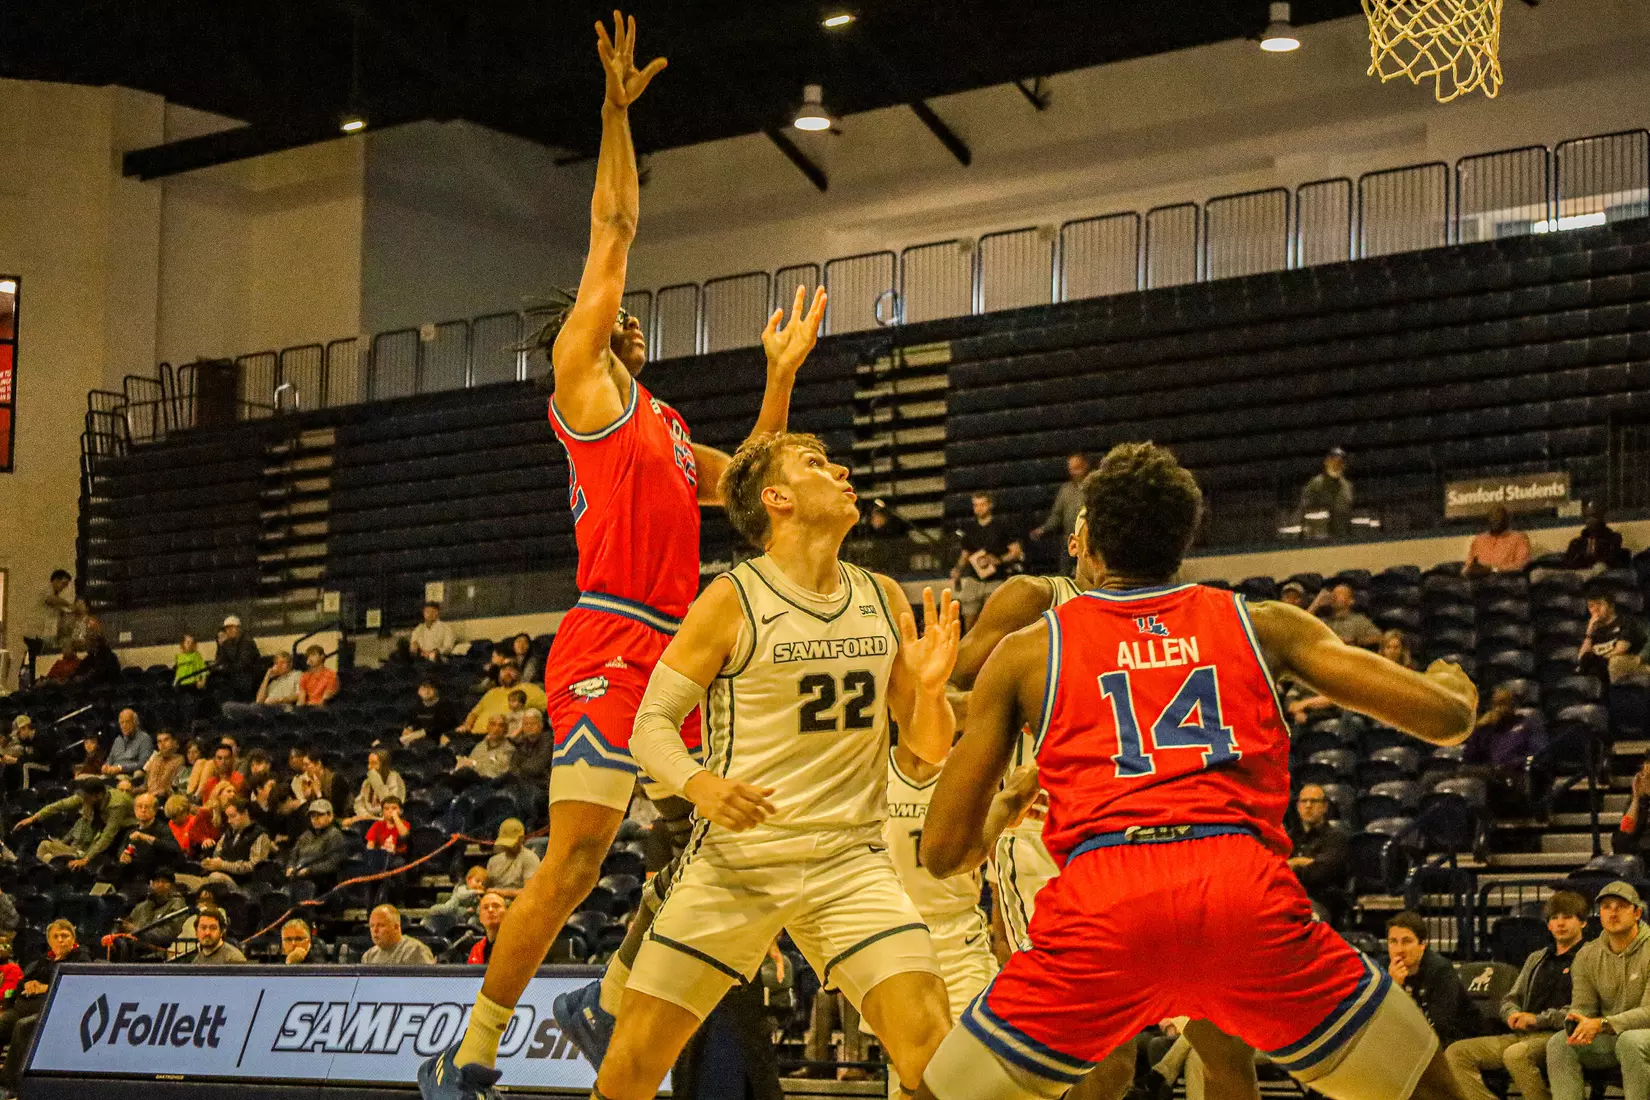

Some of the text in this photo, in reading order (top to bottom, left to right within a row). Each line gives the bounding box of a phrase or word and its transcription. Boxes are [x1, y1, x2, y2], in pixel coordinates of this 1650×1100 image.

[1448, 482, 1565, 505] Samford Students
[773, 635, 888, 664] SAMFORD
[1117, 636, 1200, 670] ALLEN
[798, 669, 876, 734] 22
[1097, 664, 1242, 778] 14
[107, 1002, 227, 1048] Follett
